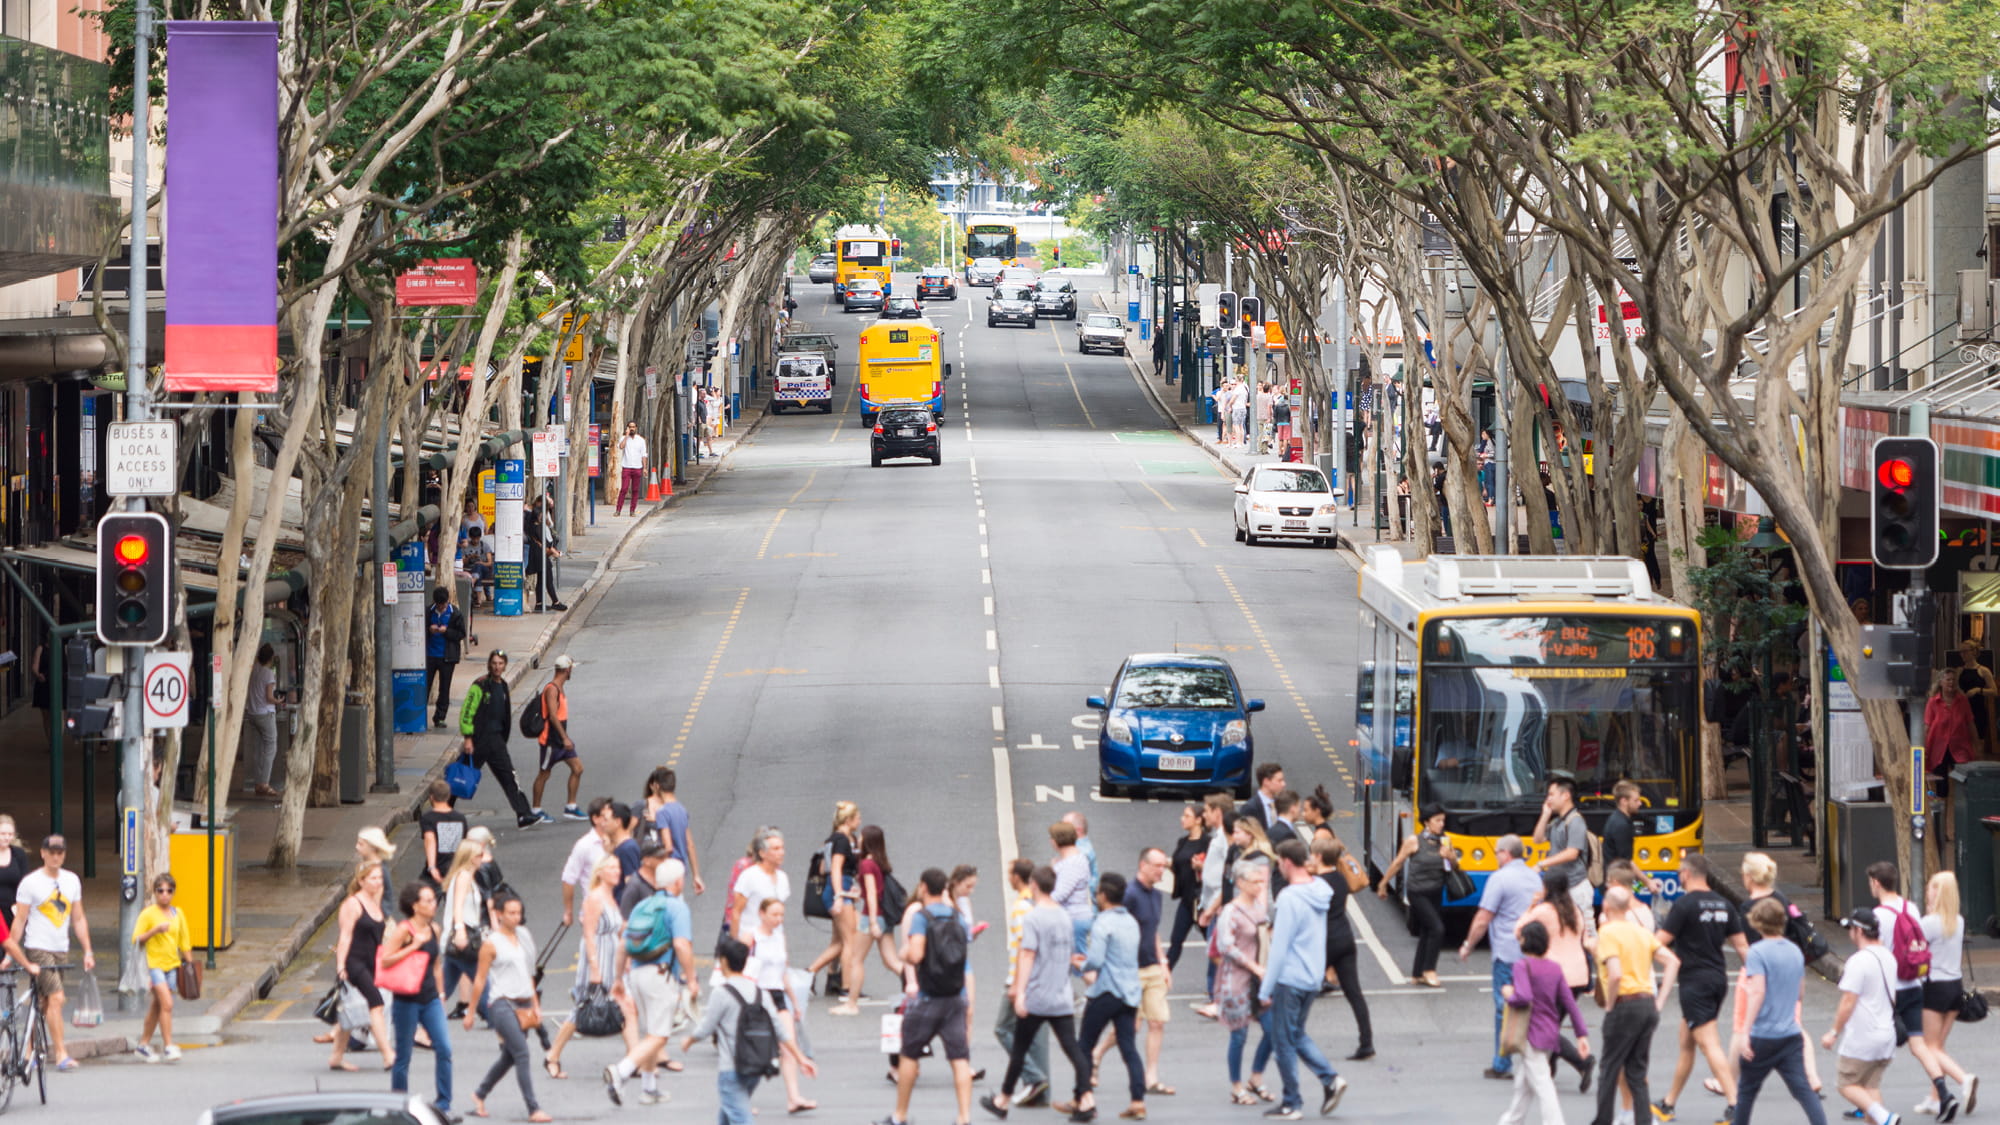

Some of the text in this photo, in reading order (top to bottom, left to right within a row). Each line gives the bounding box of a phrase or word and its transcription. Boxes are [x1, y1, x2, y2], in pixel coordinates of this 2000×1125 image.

[891, 332, 907, 340] 379
[113, 428, 168, 440] BUSES &
[120, 444, 161, 456] LOCAL
[116, 461, 167, 472] ACCESS
[128, 476, 154, 488] ONLY
[510, 484, 523, 498] 40
[407, 572, 424, 589] 39
[1560, 626, 1590, 641] BUZ
[151, 676, 181, 702] 40
